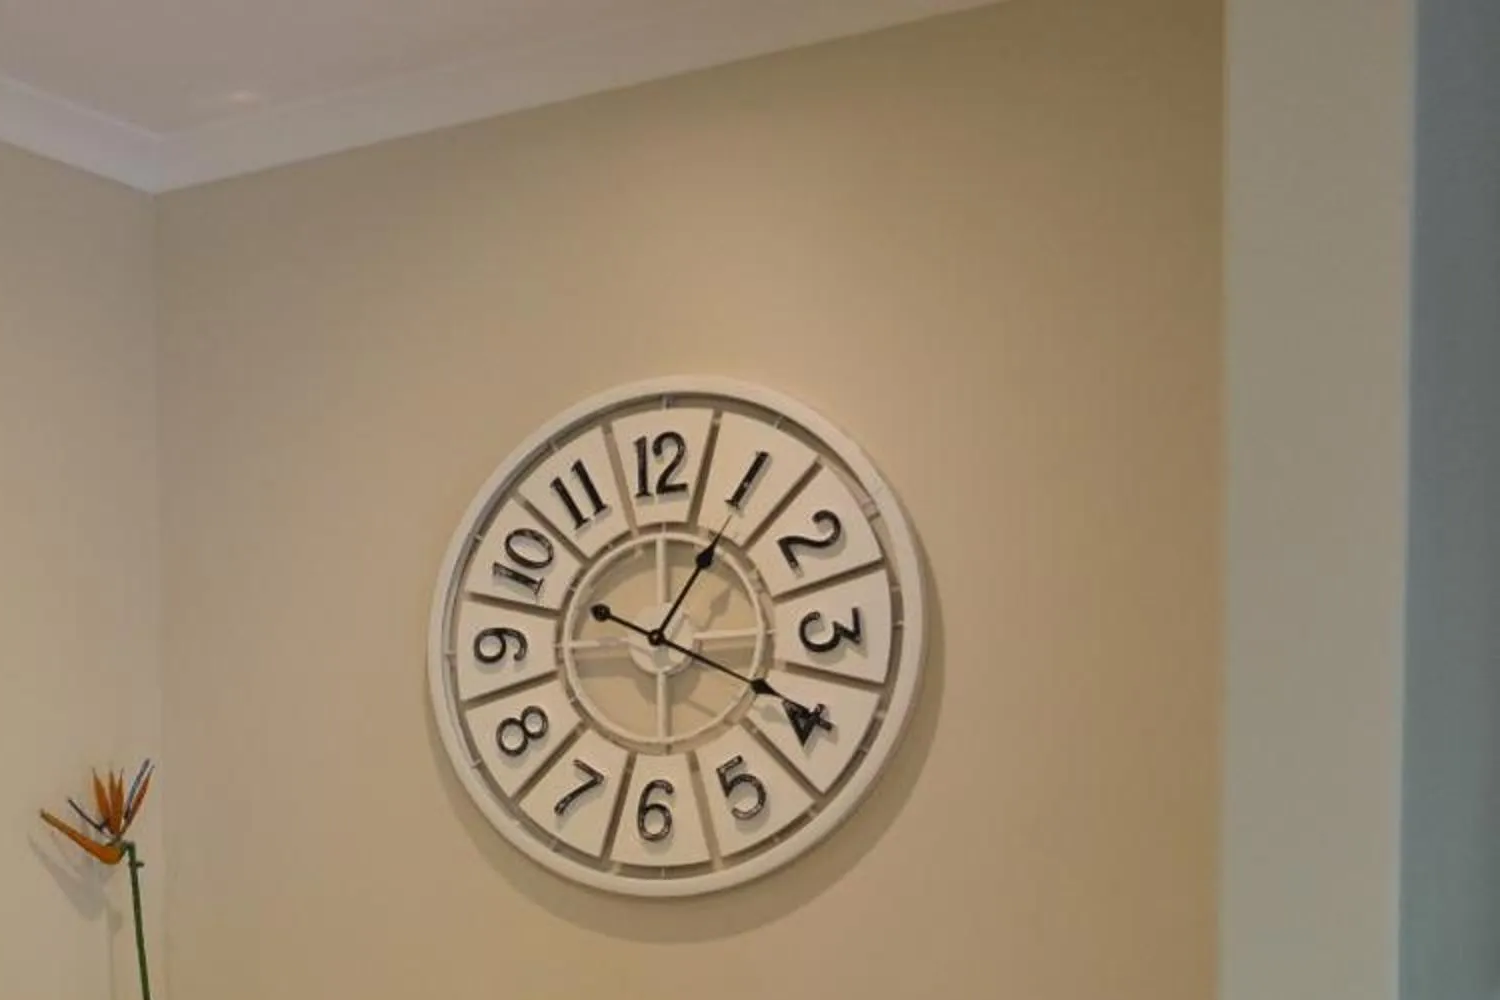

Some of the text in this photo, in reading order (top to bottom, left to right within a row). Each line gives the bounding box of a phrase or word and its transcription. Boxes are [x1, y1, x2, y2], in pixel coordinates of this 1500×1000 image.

[633, 431, 690, 499] 12
[724, 451, 770, 509] 1
[549, 460, 609, 531] 11
[492, 527, 555, 596] 10
[777, 510, 843, 573] 2
[473, 627, 528, 665] 9
[798, 607, 863, 654] 3
[495, 705, 549, 758] 8
[783, 696, 835, 748] 4
[553, 759, 605, 816] 7
[636, 779, 675, 843] 6
[715, 755, 767, 821] 5
